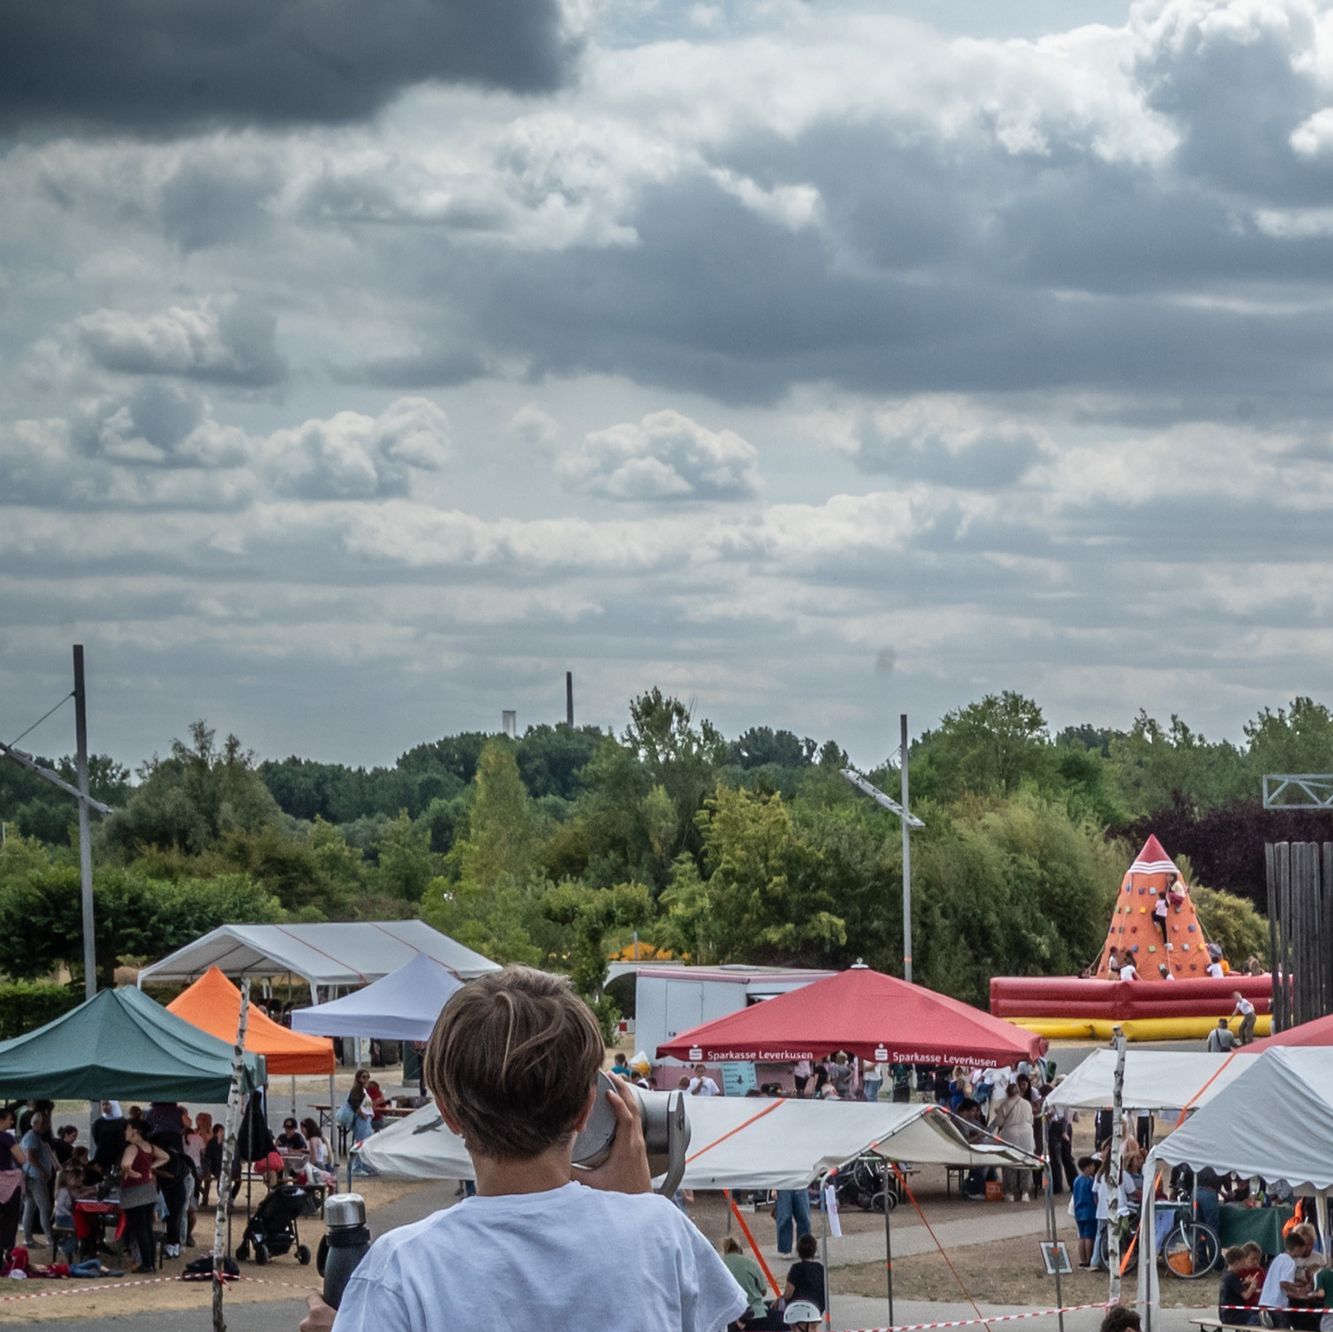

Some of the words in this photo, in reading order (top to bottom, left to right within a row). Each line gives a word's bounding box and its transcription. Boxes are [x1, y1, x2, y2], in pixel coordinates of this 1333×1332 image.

[707, 1050, 756, 1060] Sparkasse
[758, 1050, 813, 1060] Leverkusen
[892, 1052, 941, 1063] Sparkasse
[943, 1054, 997, 1067] Leverkusen
